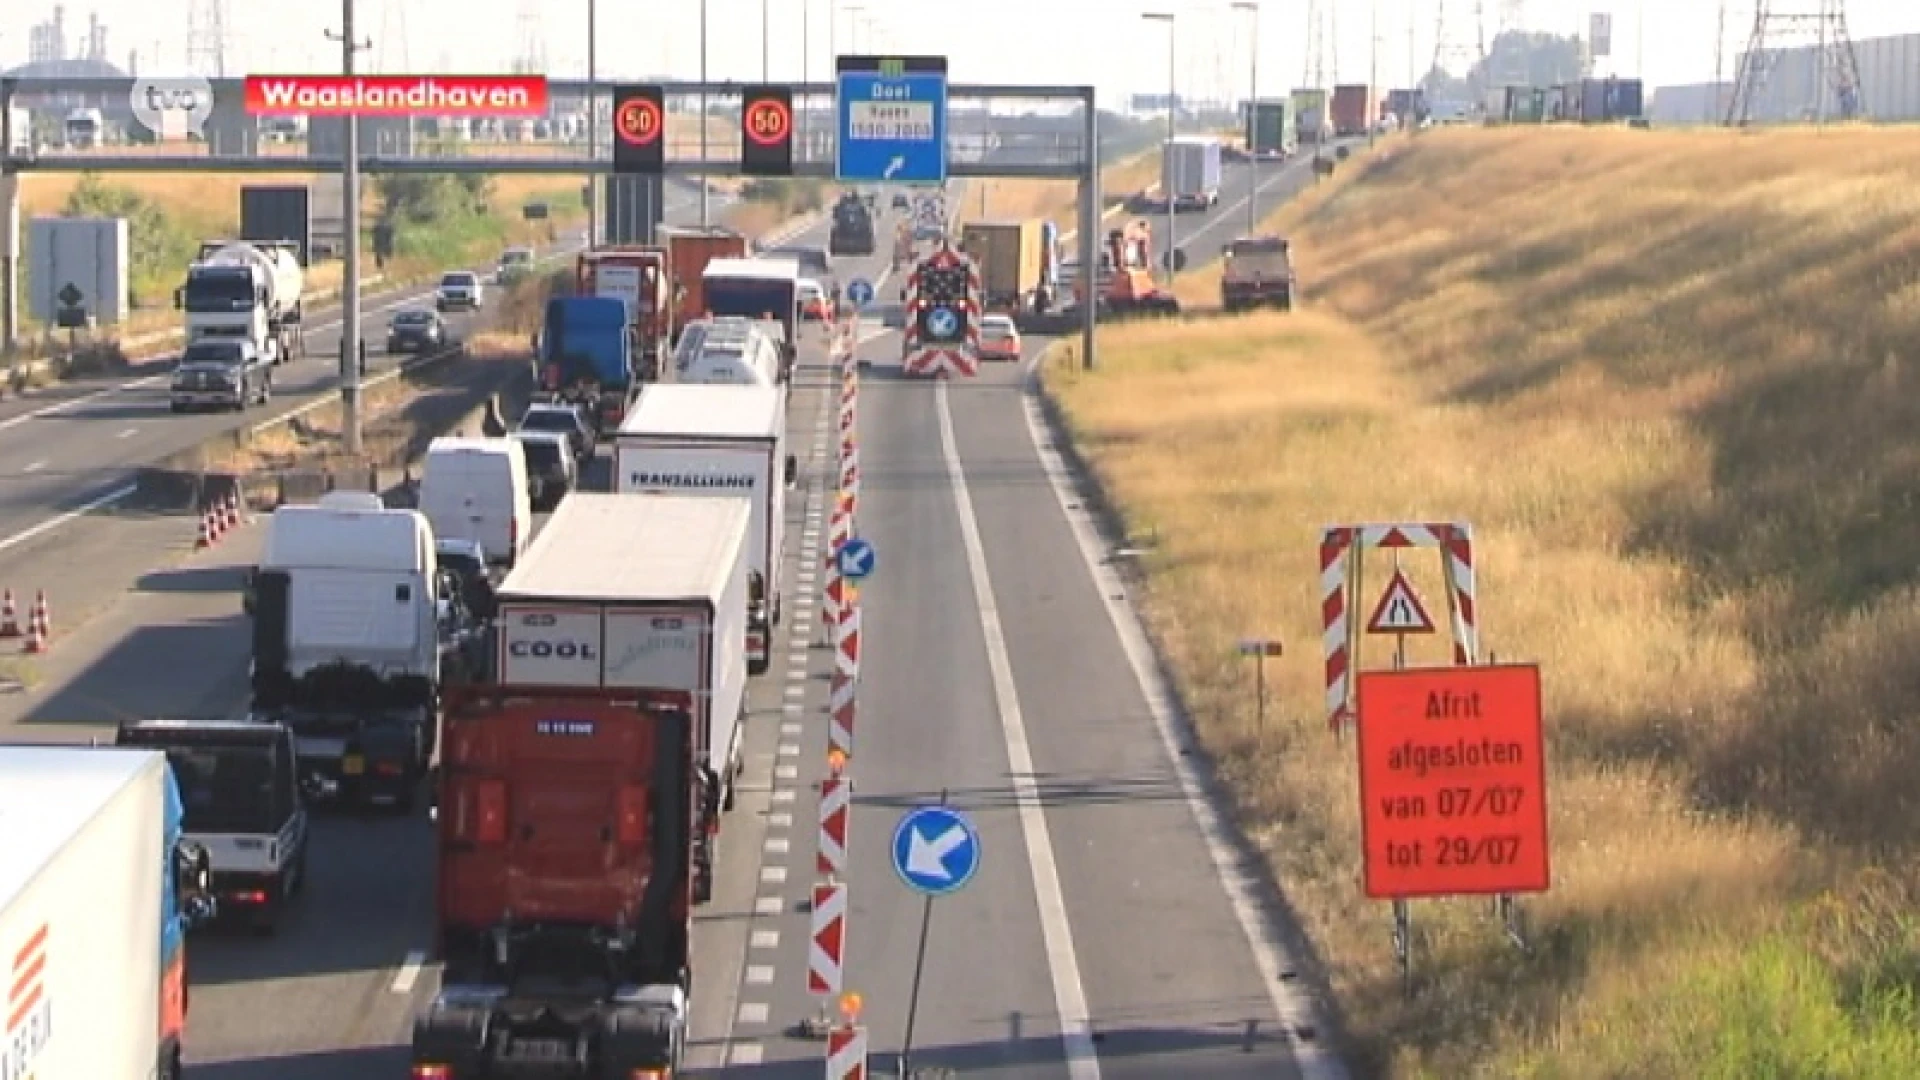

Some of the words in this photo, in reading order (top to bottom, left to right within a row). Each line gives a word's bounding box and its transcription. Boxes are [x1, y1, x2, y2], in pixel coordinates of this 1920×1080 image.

[623, 107, 651, 133] 50
[754, 107, 782, 133] 50
[630, 472, 756, 488] TRANSALLIANCE
[510, 639, 597, 661] COOL
[1425, 689, 1482, 721] Afrit
[1388, 735, 1524, 778] afgesloten
[1381, 794, 1427, 819] van
[1437, 785, 1525, 817] 07/07
[1386, 839, 1423, 868] tot
[1436, 834, 1522, 867] 29/07
